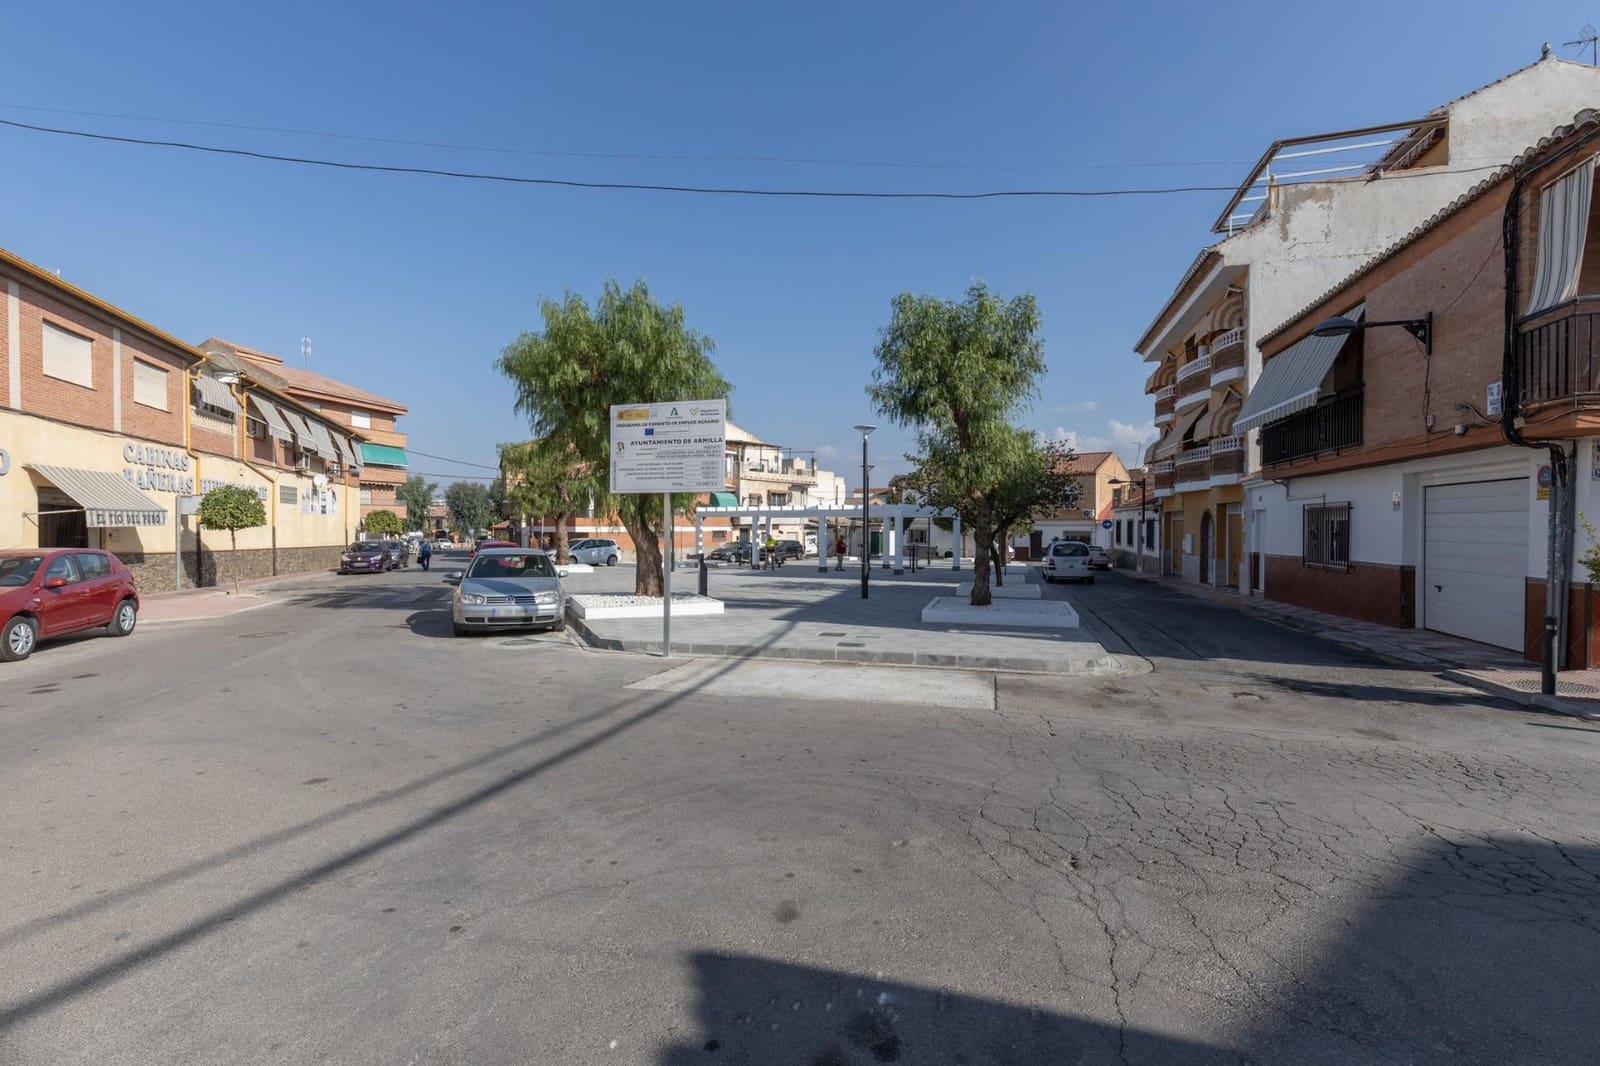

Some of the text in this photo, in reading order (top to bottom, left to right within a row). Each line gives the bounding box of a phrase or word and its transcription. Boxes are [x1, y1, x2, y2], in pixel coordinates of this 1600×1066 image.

[123, 442, 189, 472] CABINAS
[123, 467, 194, 494] BAÑERAS
[97, 513, 106, 524] EL
[126, 514, 140, 524] DEL
